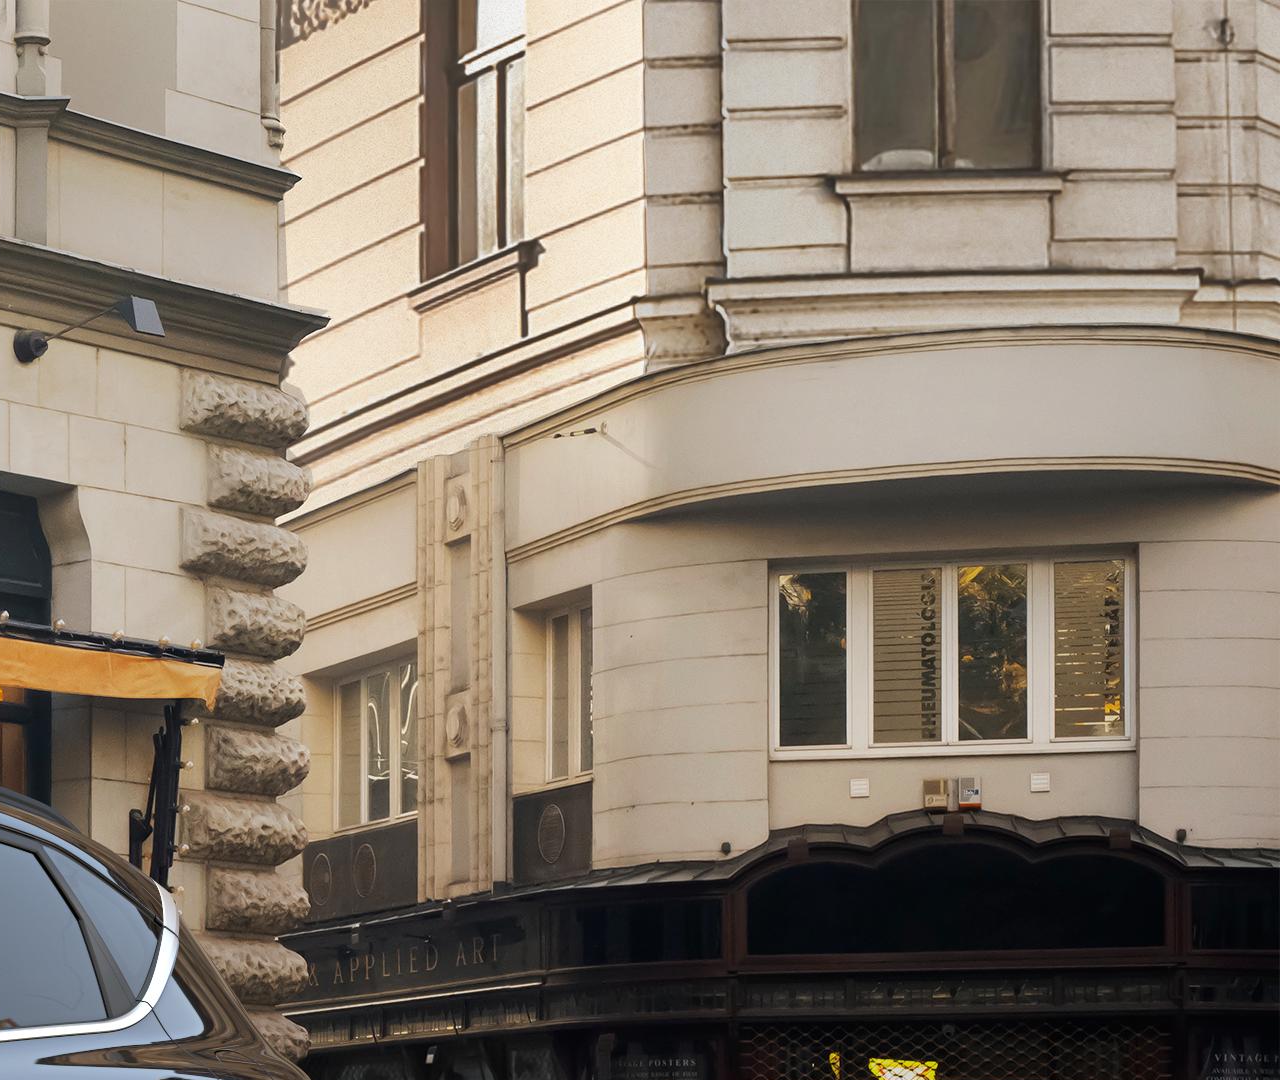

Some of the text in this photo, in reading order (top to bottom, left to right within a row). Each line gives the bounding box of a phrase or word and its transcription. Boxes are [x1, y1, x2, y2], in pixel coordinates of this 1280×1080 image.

[333, 944, 439, 985] APPLIED
[455, 933, 502, 968] ART
[648, 1058, 697, 1068] POSTERS
[1214, 1053, 1270, 1063] VINTAGE
